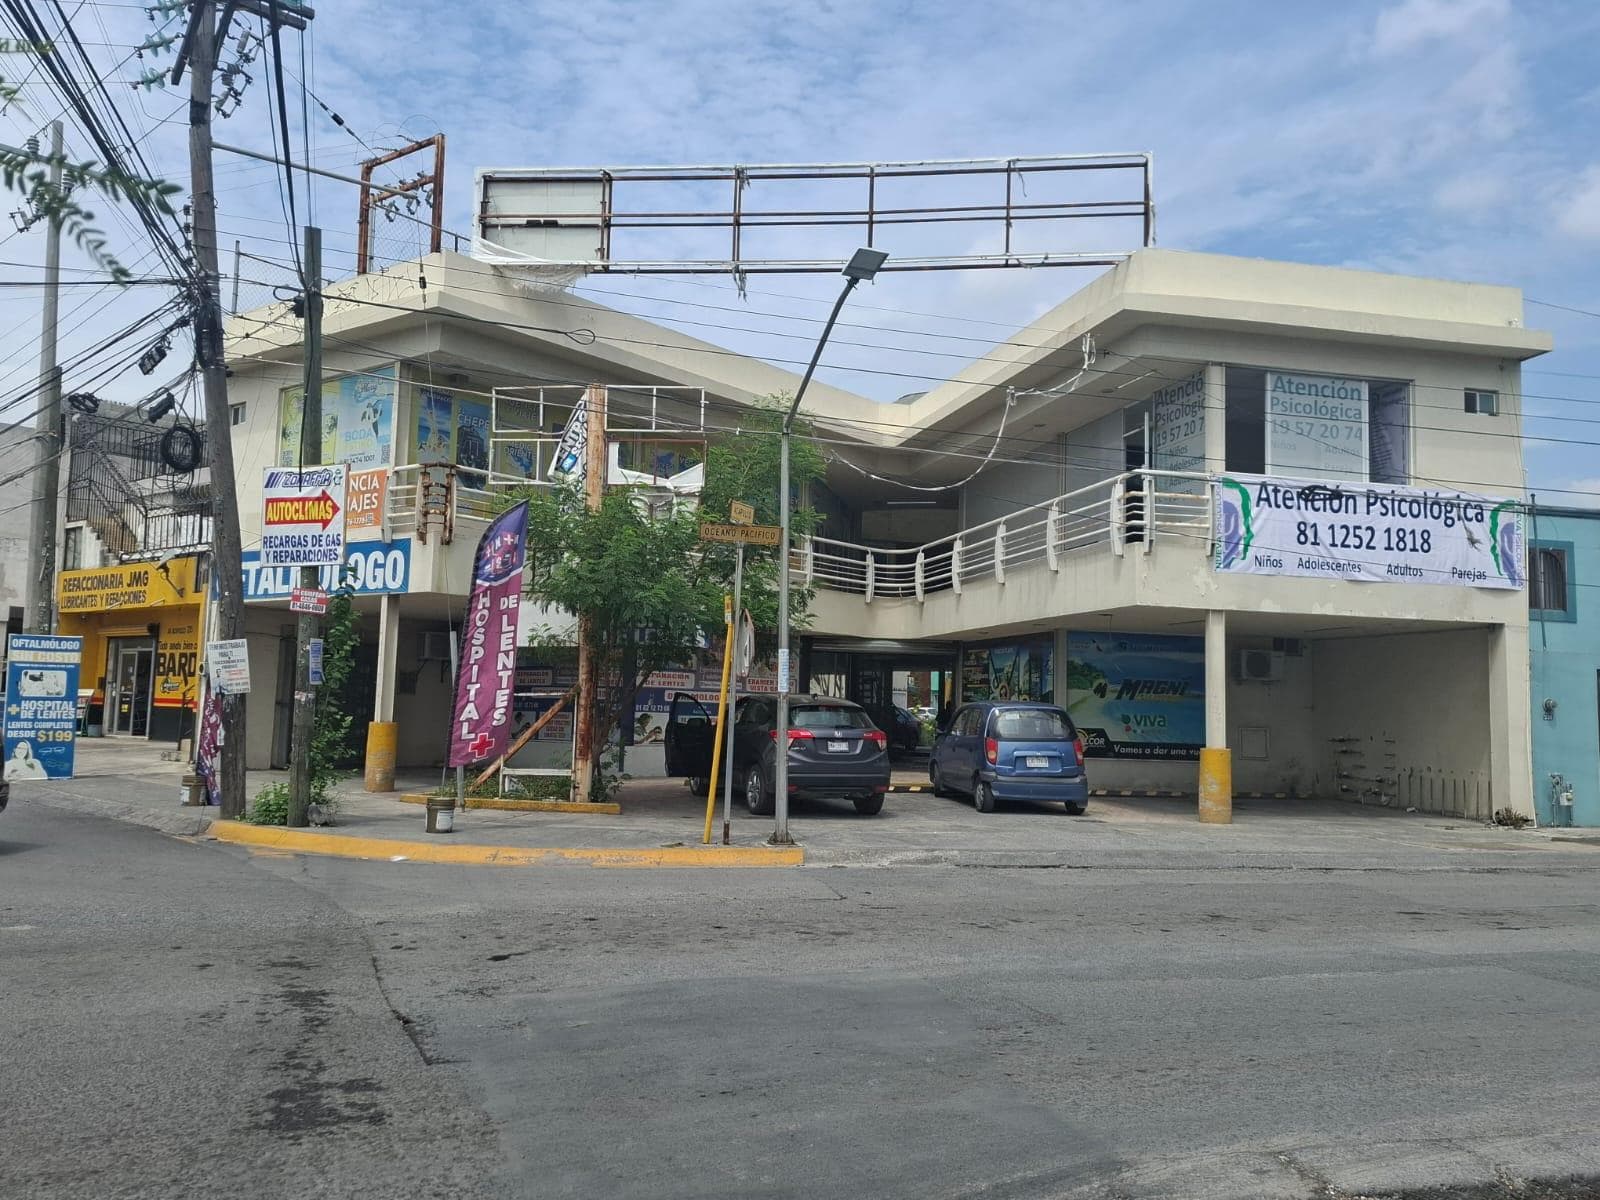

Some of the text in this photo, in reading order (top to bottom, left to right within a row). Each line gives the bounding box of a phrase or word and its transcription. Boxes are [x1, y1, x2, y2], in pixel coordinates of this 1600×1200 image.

[1156, 373, 1205, 410] Atenció
[1274, 376, 1361, 400] Atención
[1156, 396, 1205, 425] Psicológi
[1271, 397, 1361, 420] Psicológica
[344, 428, 373, 441] BODA
[1170, 426, 1181, 442] 57
[1184, 420, 1196, 437] 20
[1199, 416, 1205, 432] 7
[1296, 422, 1314, 437] 57
[1321, 424, 1339, 439] 20
[1344, 426, 1362, 441] 74
[349, 474, 379, 491] NCIA
[266, 500, 333, 521] AUTOCLIMAS
[347, 492, 378, 513] IAJES
[1256, 481, 1484, 528] Atención Psicológica
[263, 533, 341, 549] RECARGAS DE GAS
[704, 527, 776, 540] OCEANO PACIFICO
[1297, 521, 1431, 553] 81 1252 1818
[265, 548, 339, 563] Y REPARACIONES
[217, 549, 404, 597] TALLOGO
[1254, 555, 1487, 582] Niños Adolescentes Adultos Parejas
[63, 571, 148, 592] REFACCIONARIA JMG
[61, 594, 97, 609] LUBRICANTES
[100, 593, 104, 606] Y
[501, 595, 518, 610] DE
[12, 638, 80, 650] OFTALMÓLOGO
[157, 652, 197, 677] BARD
[459, 590, 490, 739] HOSPITAL
[492, 614, 516, 726] LENTES
[20, 700, 75, 711] HOSPITAL
[20, 711, 75, 719] DE LENTES
[1134, 714, 1167, 727] viva
[7, 730, 73, 742] DESDE $199
[1114, 744, 1142, 754] Vamos
[1153, 745, 1167, 754] dar
